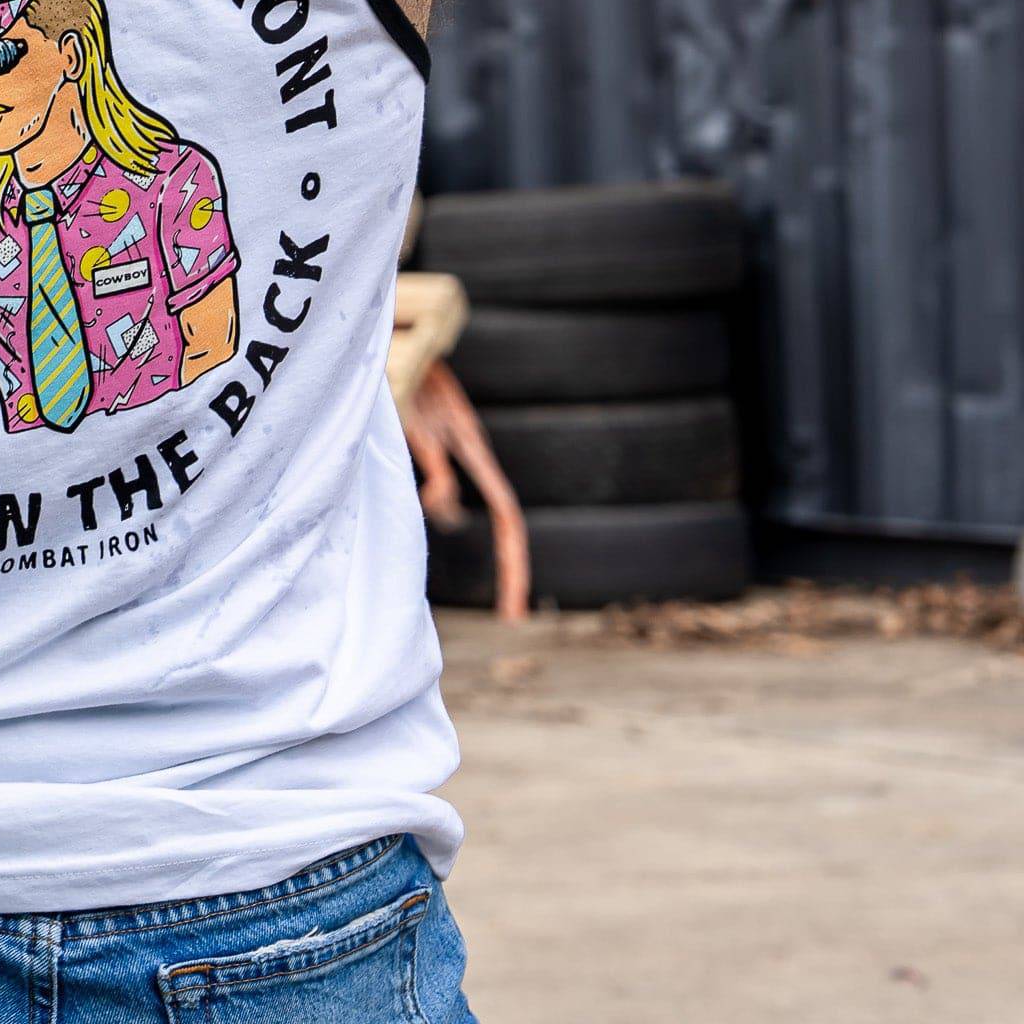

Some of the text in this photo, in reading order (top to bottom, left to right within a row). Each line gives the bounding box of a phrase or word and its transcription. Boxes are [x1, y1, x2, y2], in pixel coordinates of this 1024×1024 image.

[96, 269, 147, 287] COWBOY
[66, 429, 205, 532] THE
[208, 230, 330, 438] BACK
[99, 522, 159, 560] IRON
